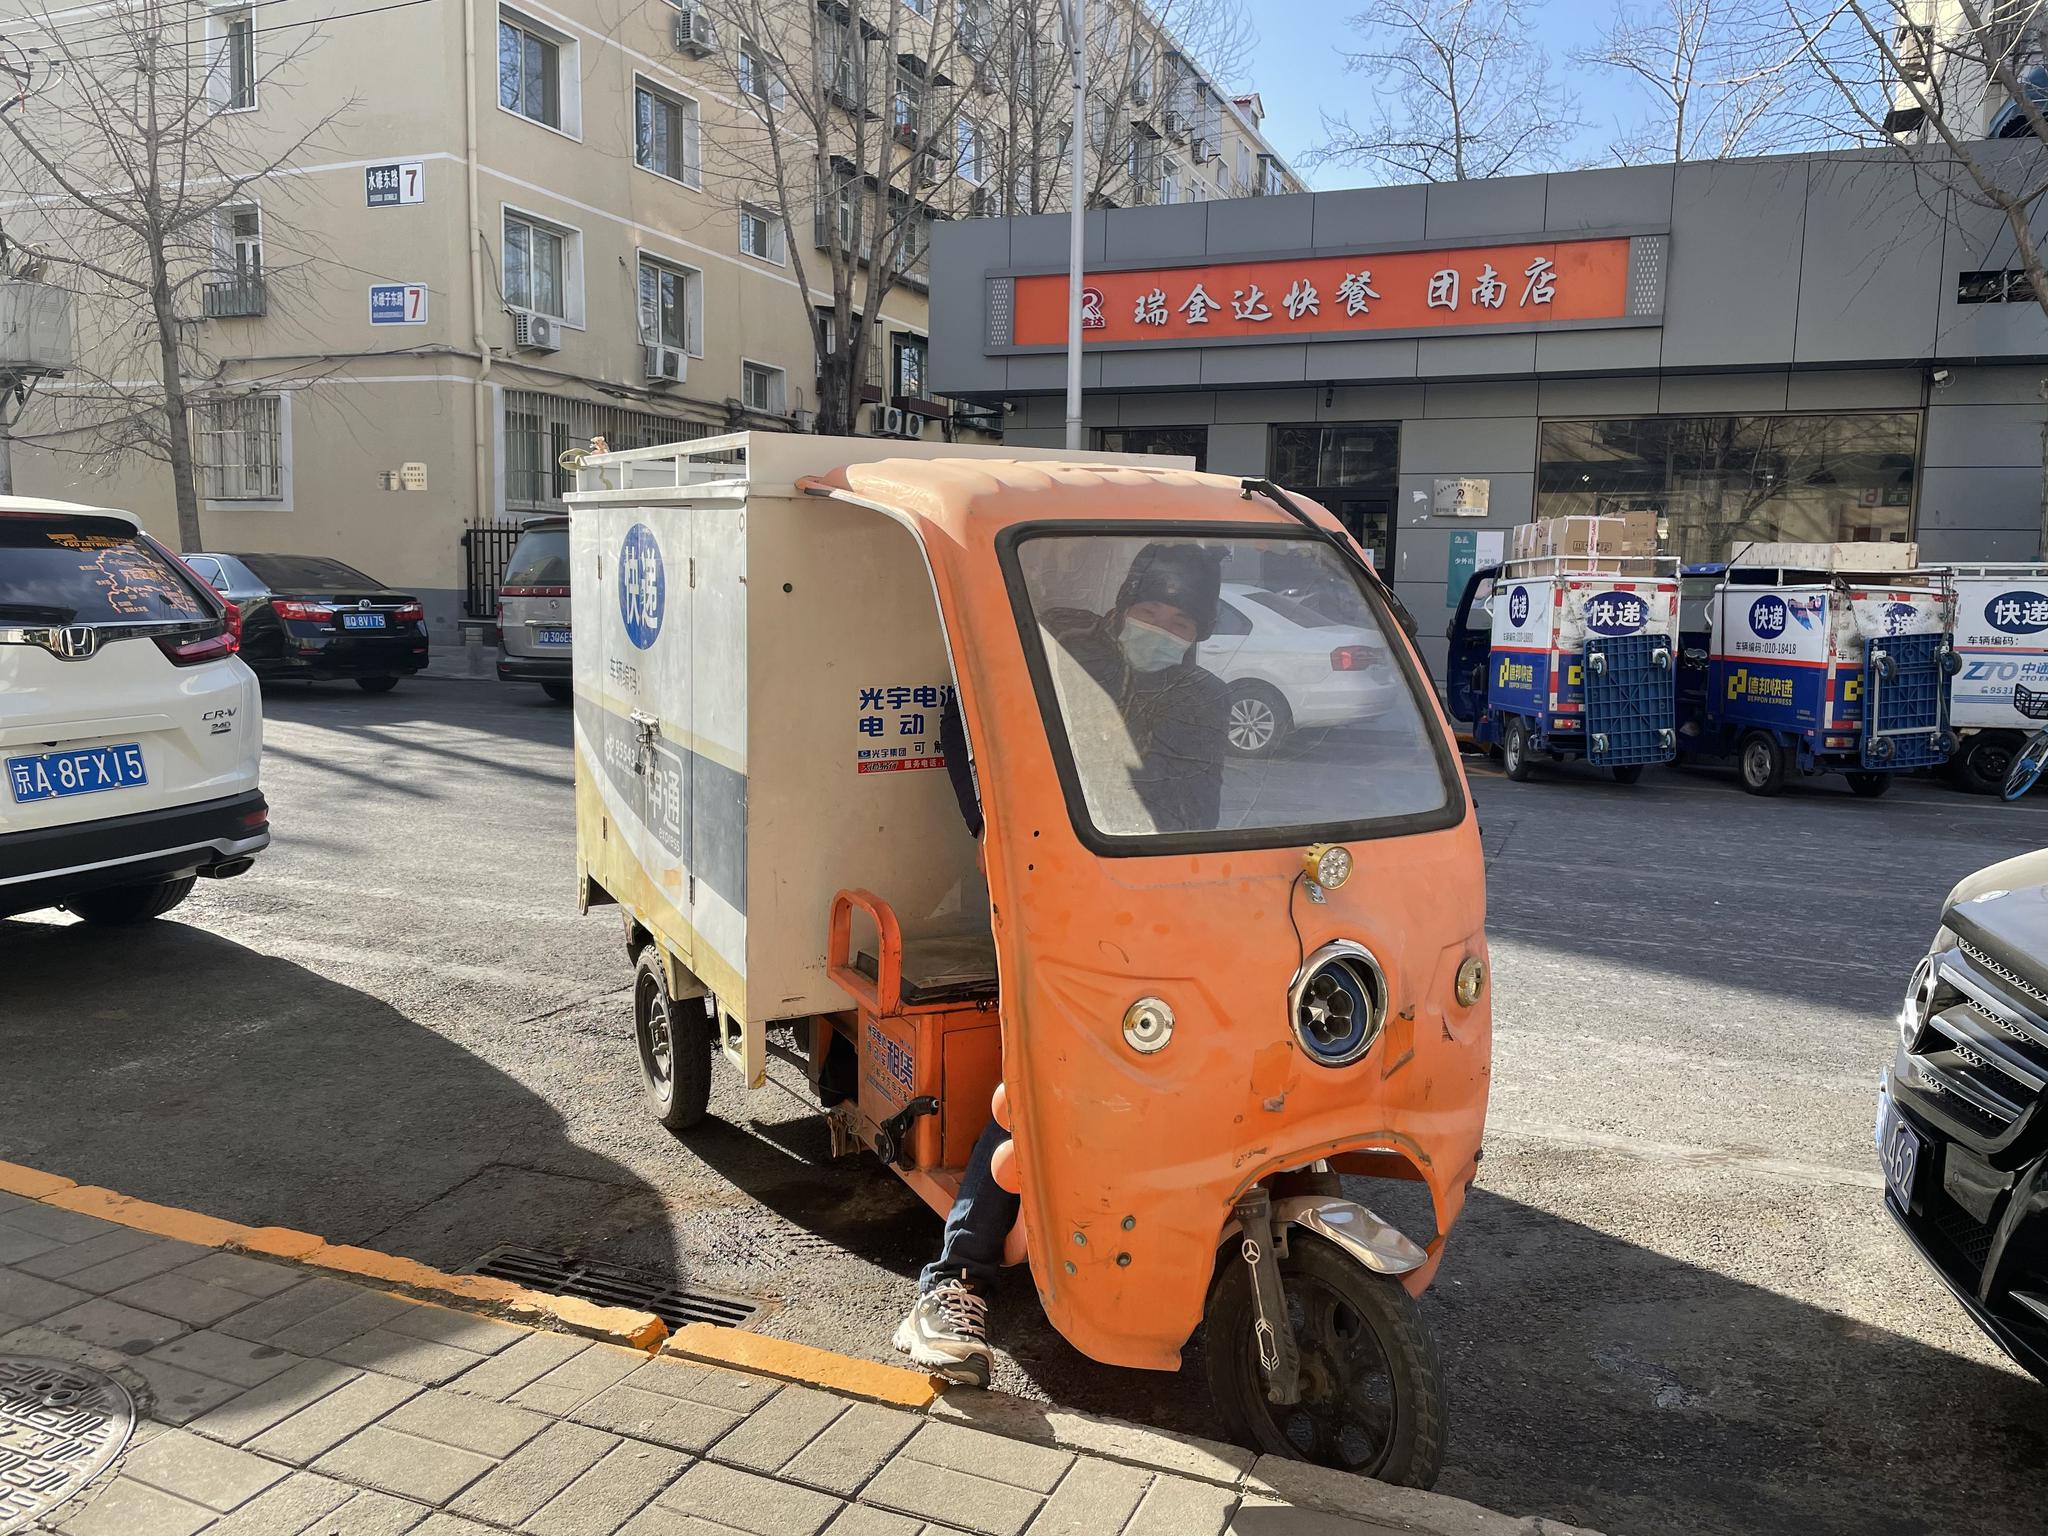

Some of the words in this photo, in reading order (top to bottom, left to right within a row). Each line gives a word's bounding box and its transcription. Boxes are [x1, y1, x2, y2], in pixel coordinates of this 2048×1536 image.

[405, 169, 417, 197] 7
[409, 289, 420, 319] 7
[1134, 270, 1381, 326] 瑞金达快餐
[1427, 257, 1557, 312] 团南店
[624, 545, 658, 629] 快递
[1511, 594, 1527, 619] 快递
[1592, 600, 1640, 626] 快递
[1754, 604, 1784, 631] 快递
[1995, 600, 2048, 626] 快递
[1967, 636, 2019, 646] 车辆编码:
[1963, 661, 2019, 681] ZTO
[1748, 677, 1793, 698] 德邦快递
[658, 827, 681, 852] express
[886, 1039, 913, 1092] 租赁
